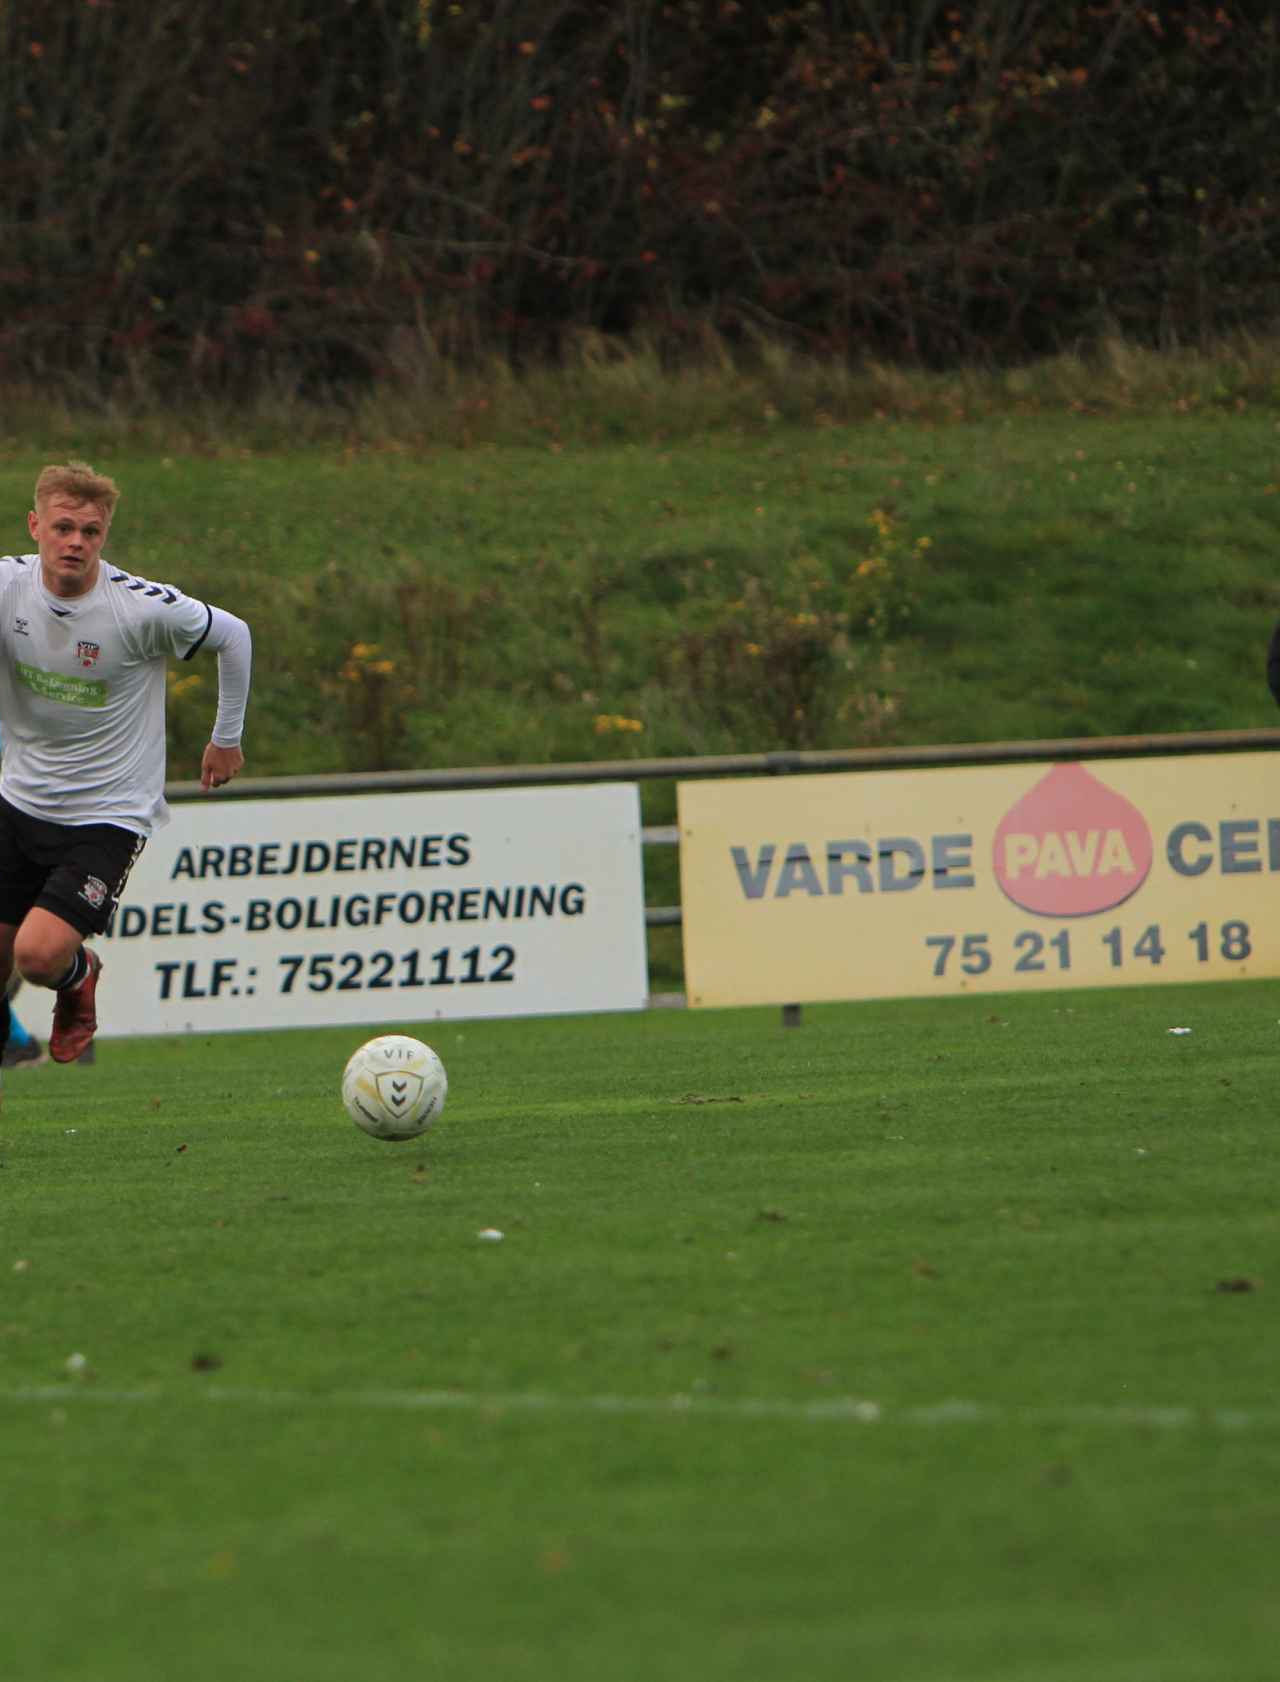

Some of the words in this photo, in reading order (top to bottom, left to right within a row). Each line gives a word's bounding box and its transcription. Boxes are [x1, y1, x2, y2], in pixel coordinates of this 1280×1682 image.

[171, 833, 470, 880] ARBEJDERNES
[730, 834, 975, 899] VARDE
[1005, 829, 1136, 879] PAVA
[89, 883, 585, 940] DELS-BOLIGFORENING
[155, 958, 257, 1001] TLF.:
[279, 944, 516, 994] 75221112
[925, 933, 992, 977] 75
[1013, 929, 1071, 972] 21
[1102, 924, 1166, 967] 14
[1188, 919, 1252, 962] 18
[384, 1049, 415, 1060] VIF
